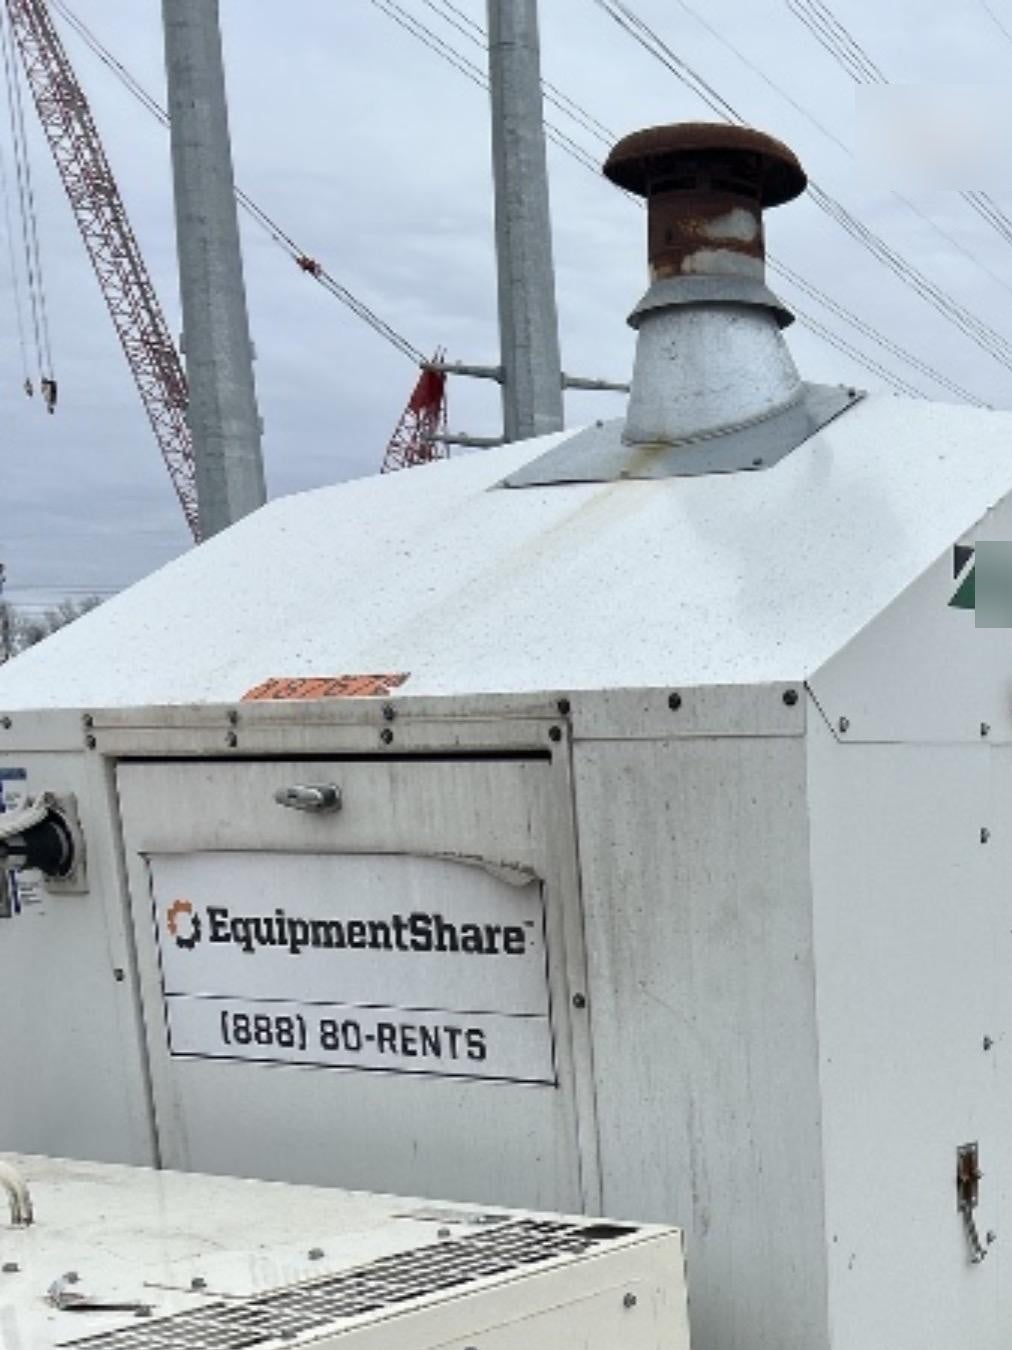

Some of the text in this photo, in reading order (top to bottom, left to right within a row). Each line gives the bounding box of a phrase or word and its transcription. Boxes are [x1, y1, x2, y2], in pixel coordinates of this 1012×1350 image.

[206, 907, 526, 954] EquipmentShare
[221, 1010, 487, 1060] (888) 80-RENTS
